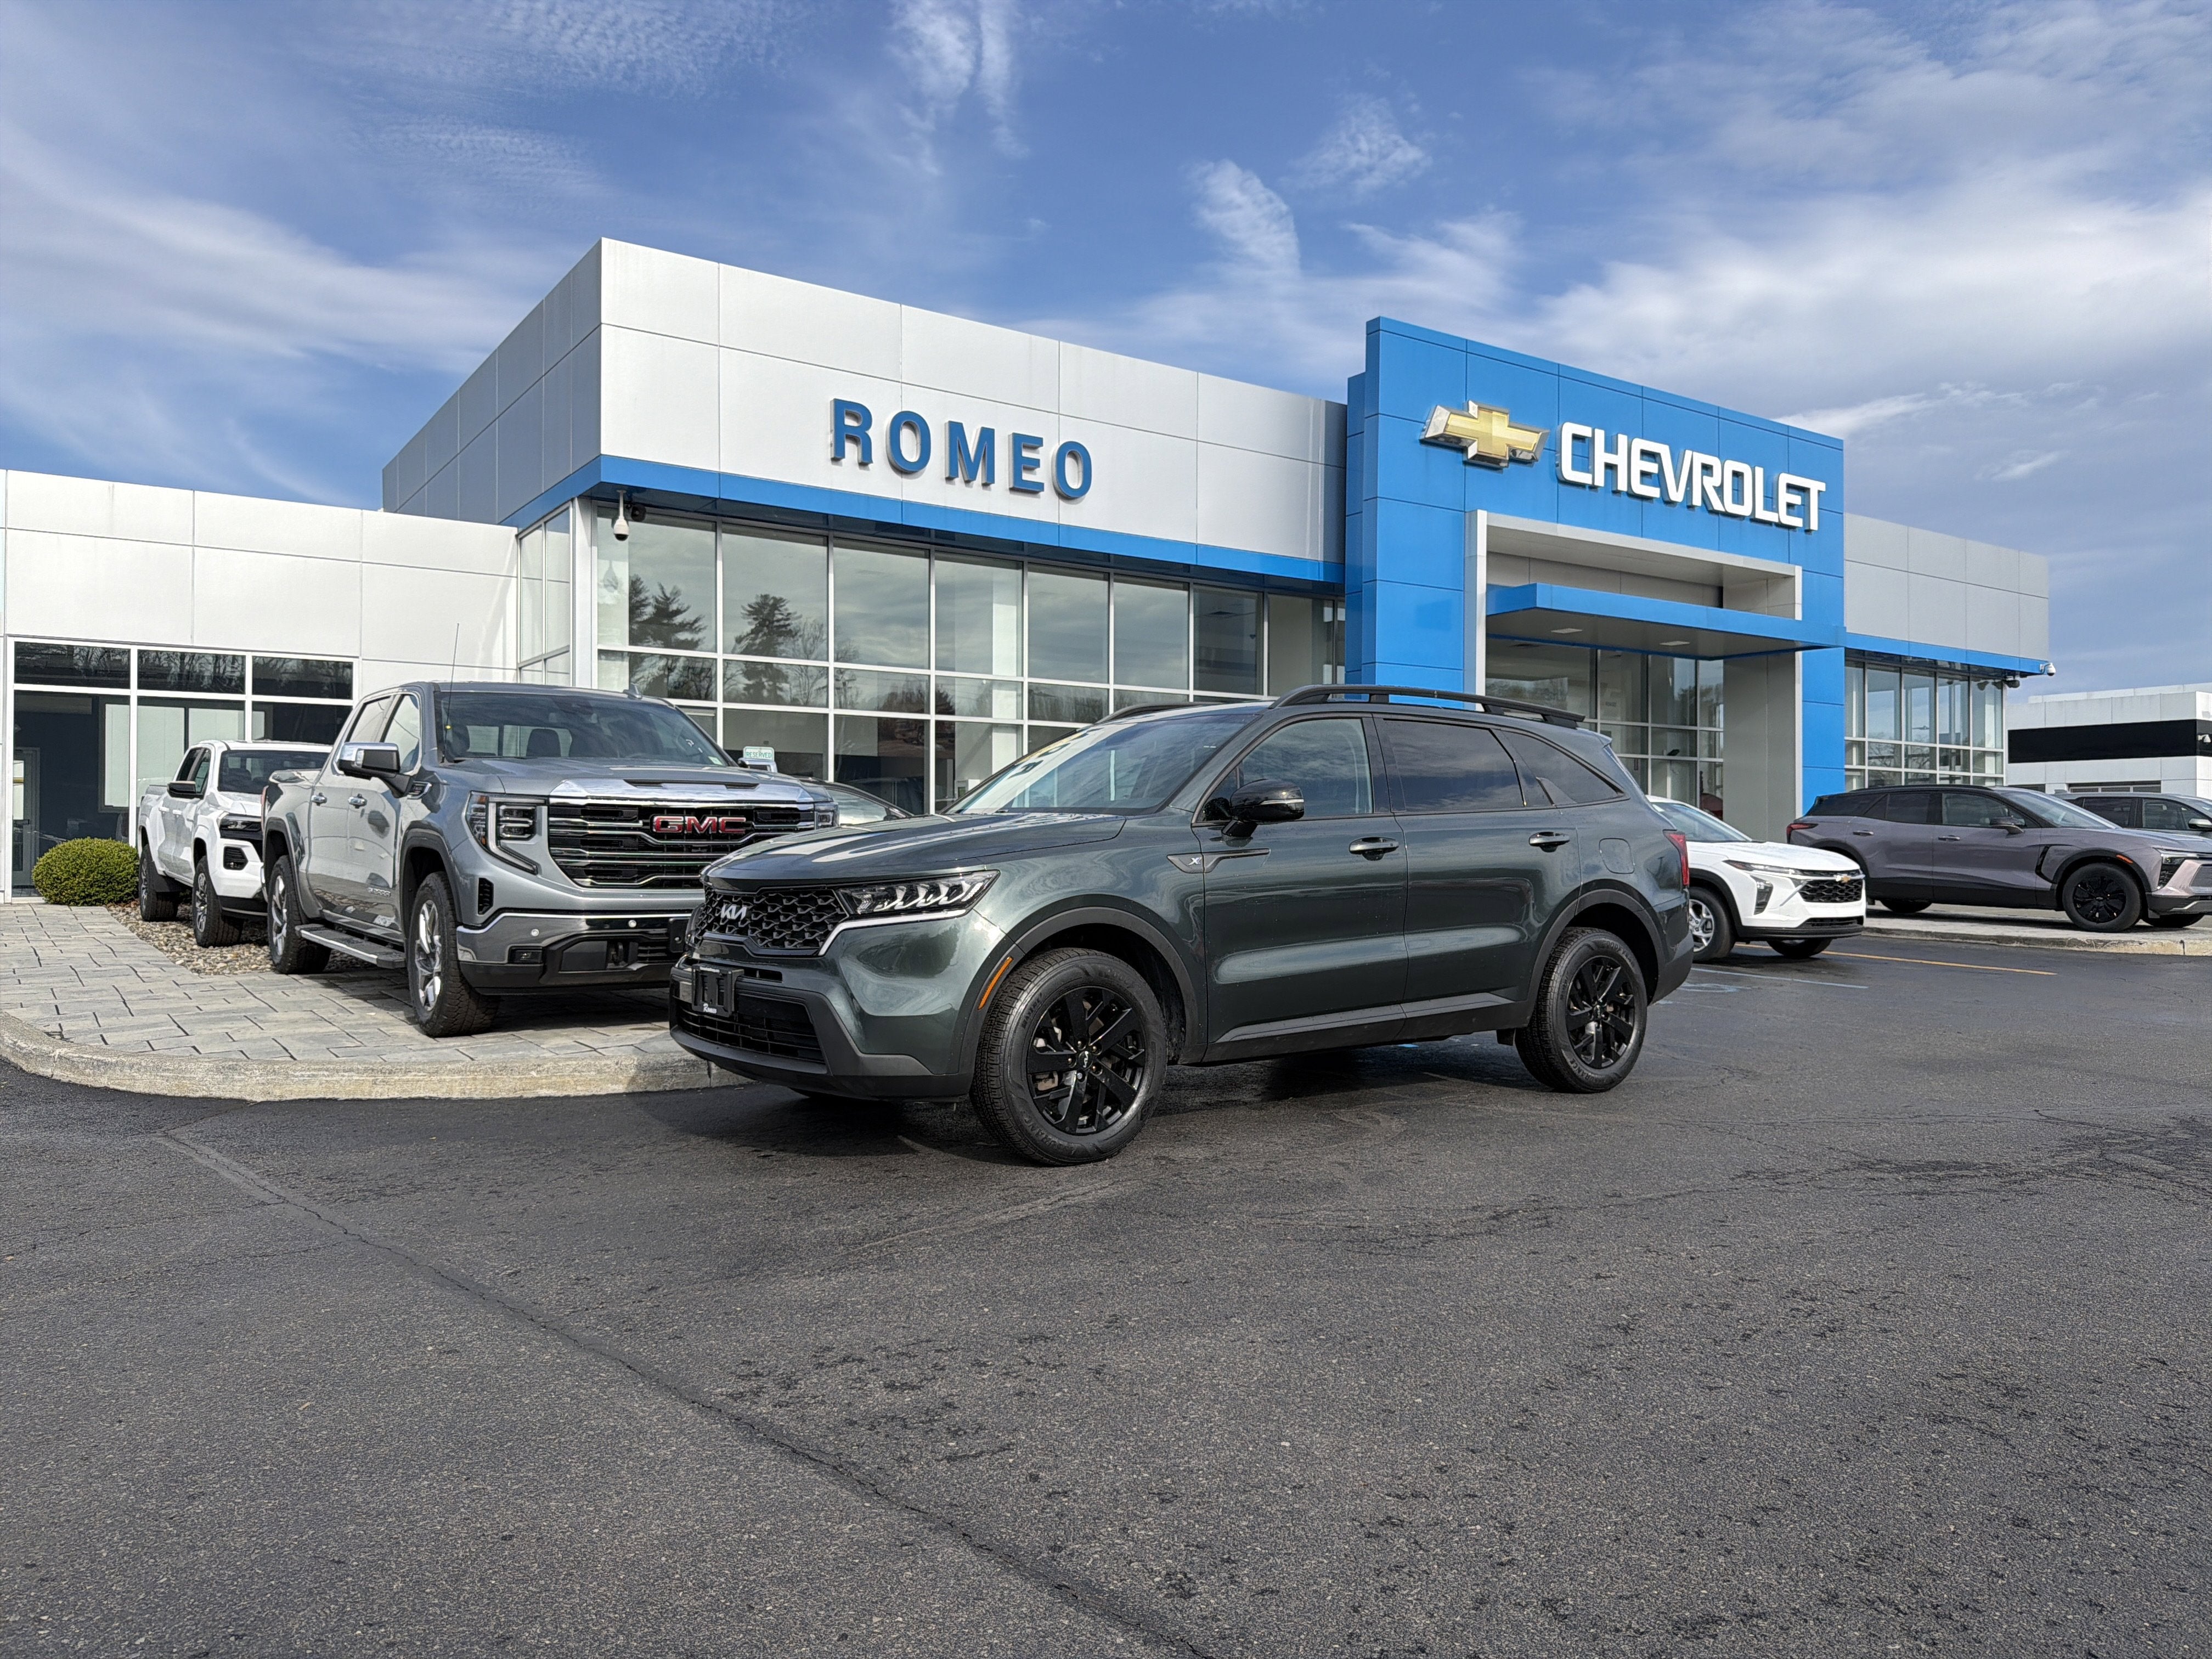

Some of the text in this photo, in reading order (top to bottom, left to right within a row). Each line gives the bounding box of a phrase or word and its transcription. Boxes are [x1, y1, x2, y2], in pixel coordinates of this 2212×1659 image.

[830, 398, 1092, 499] ROMEO
[1557, 422, 1826, 531] CHEVROLET
[653, 816, 747, 834] GMC
[721, 905, 747, 919] KIA
[1570, 1058, 1606, 1084] URANCE
